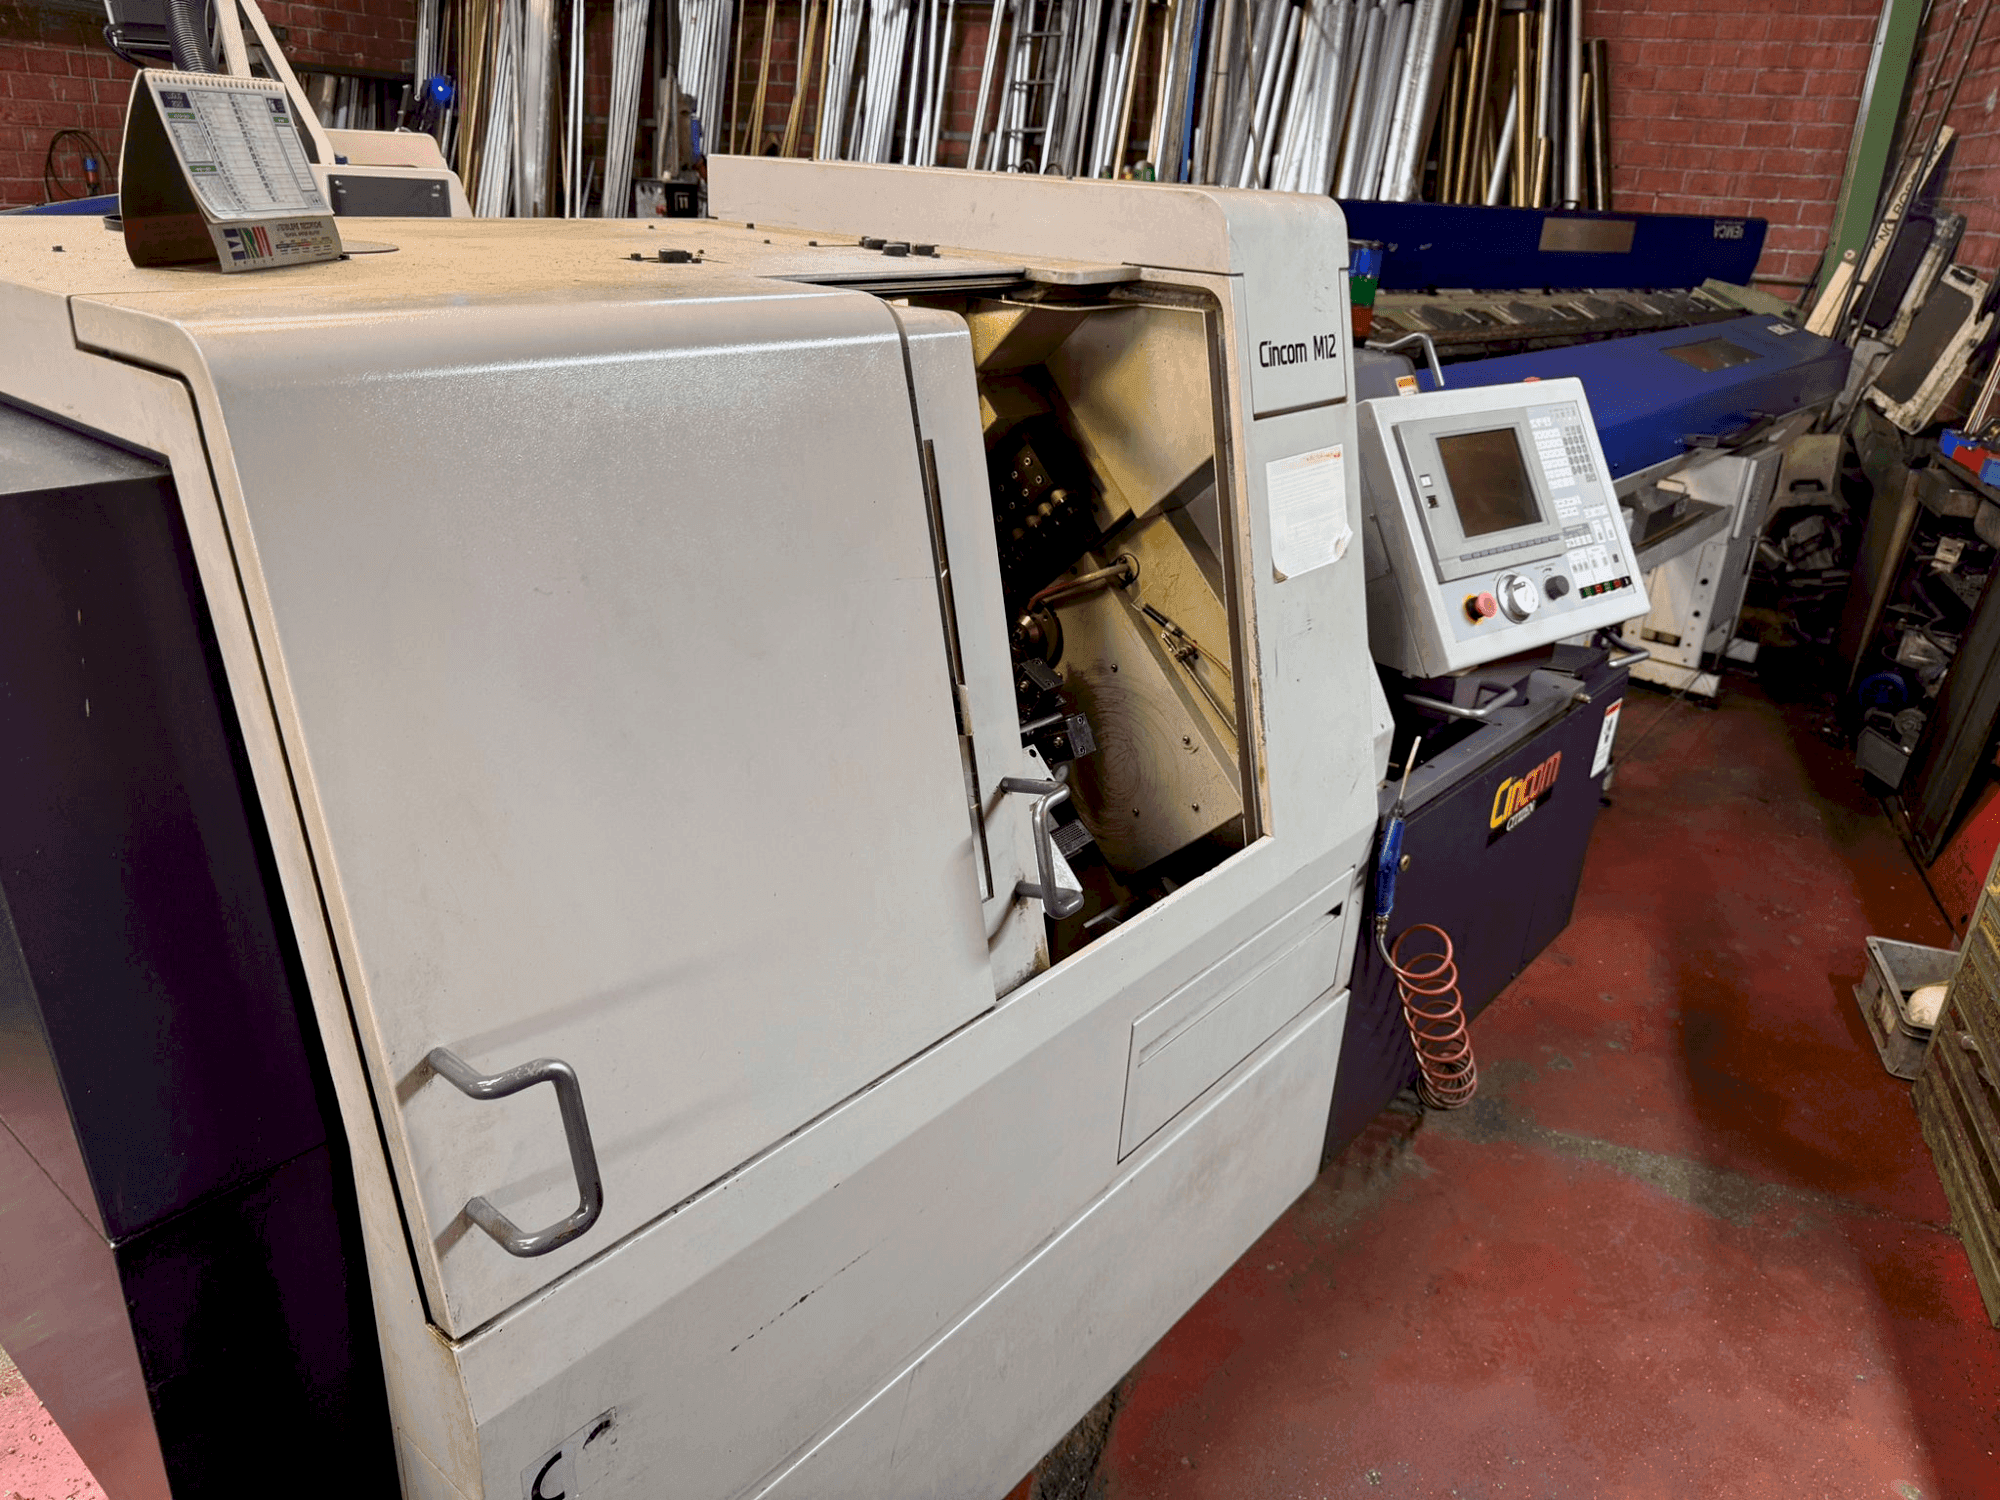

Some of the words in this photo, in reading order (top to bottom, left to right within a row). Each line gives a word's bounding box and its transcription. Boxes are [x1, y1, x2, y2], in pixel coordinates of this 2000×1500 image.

[1259, 340, 1307, 368] Cincom
[1313, 334, 1336, 361] M12
[1490, 750, 1562, 828] Cincom
